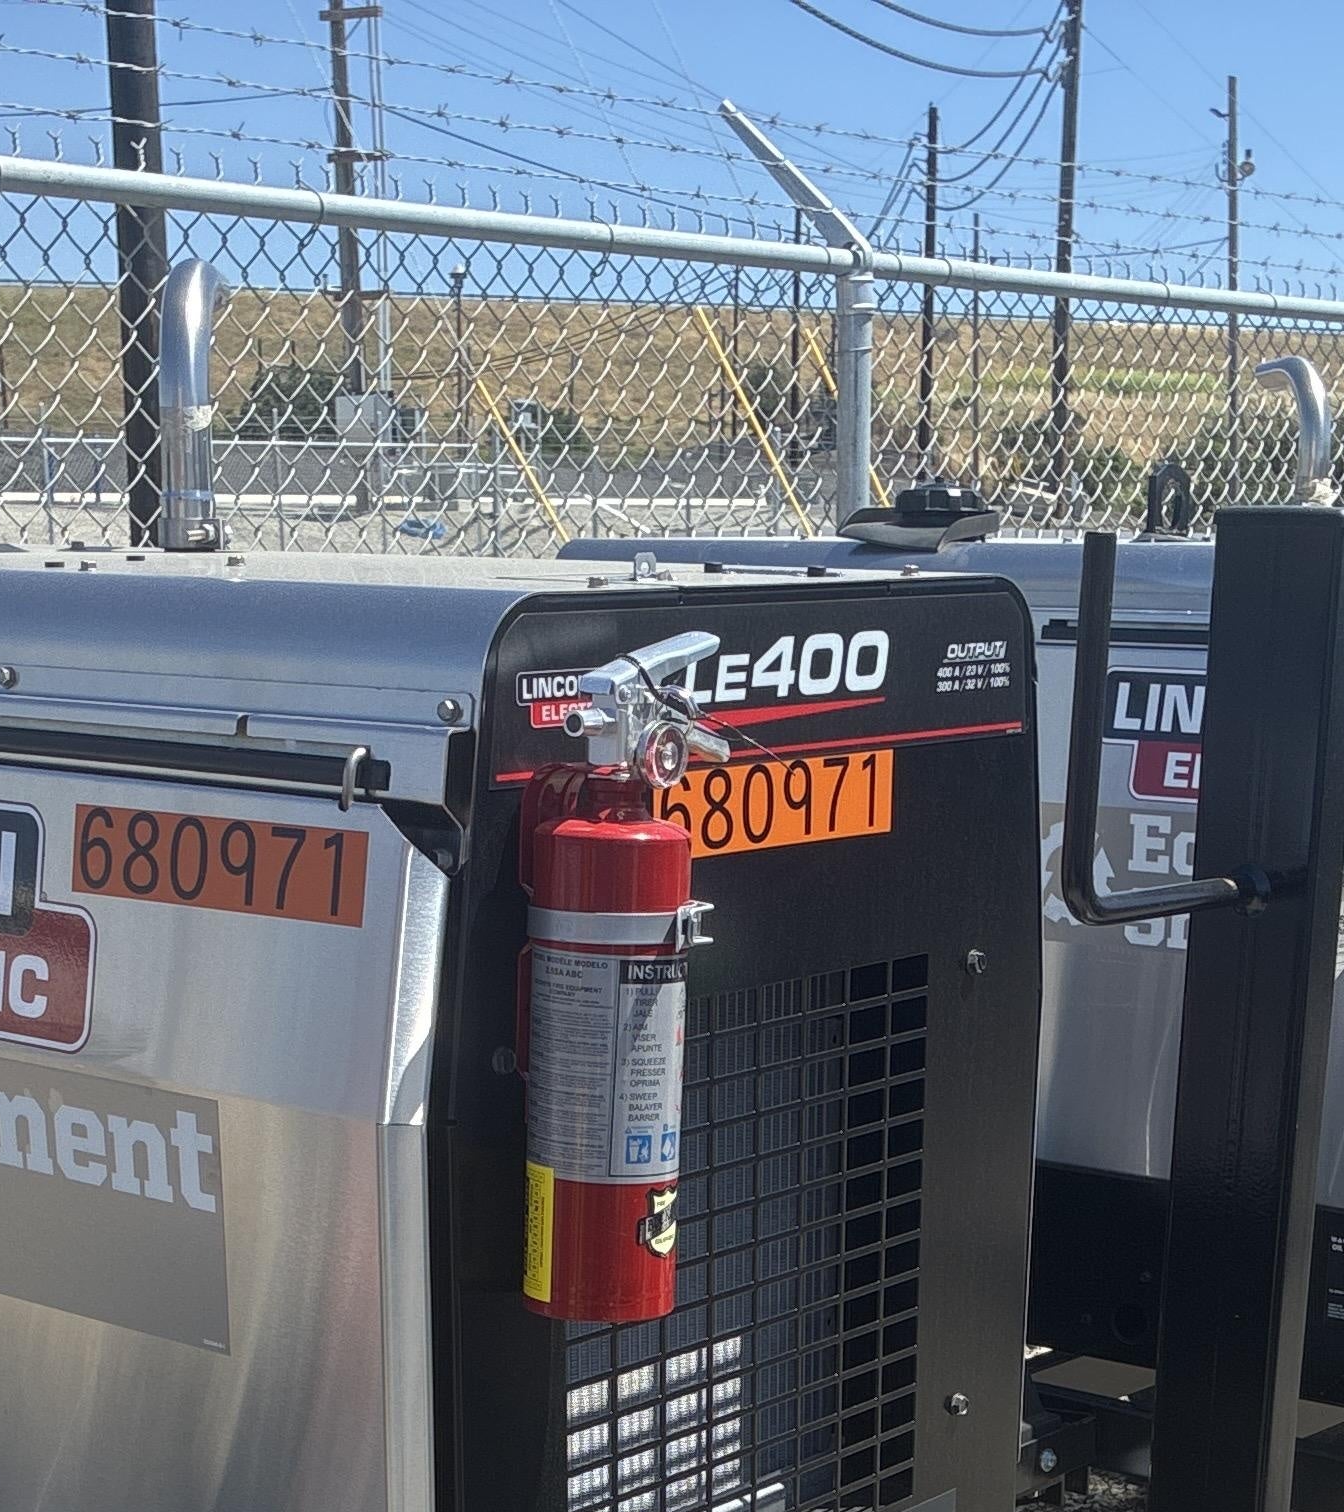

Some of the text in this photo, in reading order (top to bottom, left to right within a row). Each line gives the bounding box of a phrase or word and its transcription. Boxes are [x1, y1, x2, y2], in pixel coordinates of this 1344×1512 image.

[947, 641, 1003, 659] OUTPUT
[685, 630, 889, 704] LE400
[937, 667, 953, 678] 400
[522, 676, 580, 700] LINCO
[936, 681, 953, 692] 300
[661, 753, 878, 850] 680971
[79, 807, 345, 917] 680971
[631, 1043, 663, 1052] APUNTE
[629, 1092, 658, 1102] SWEEP
[628, 1103, 663, 1112] BALAYER
